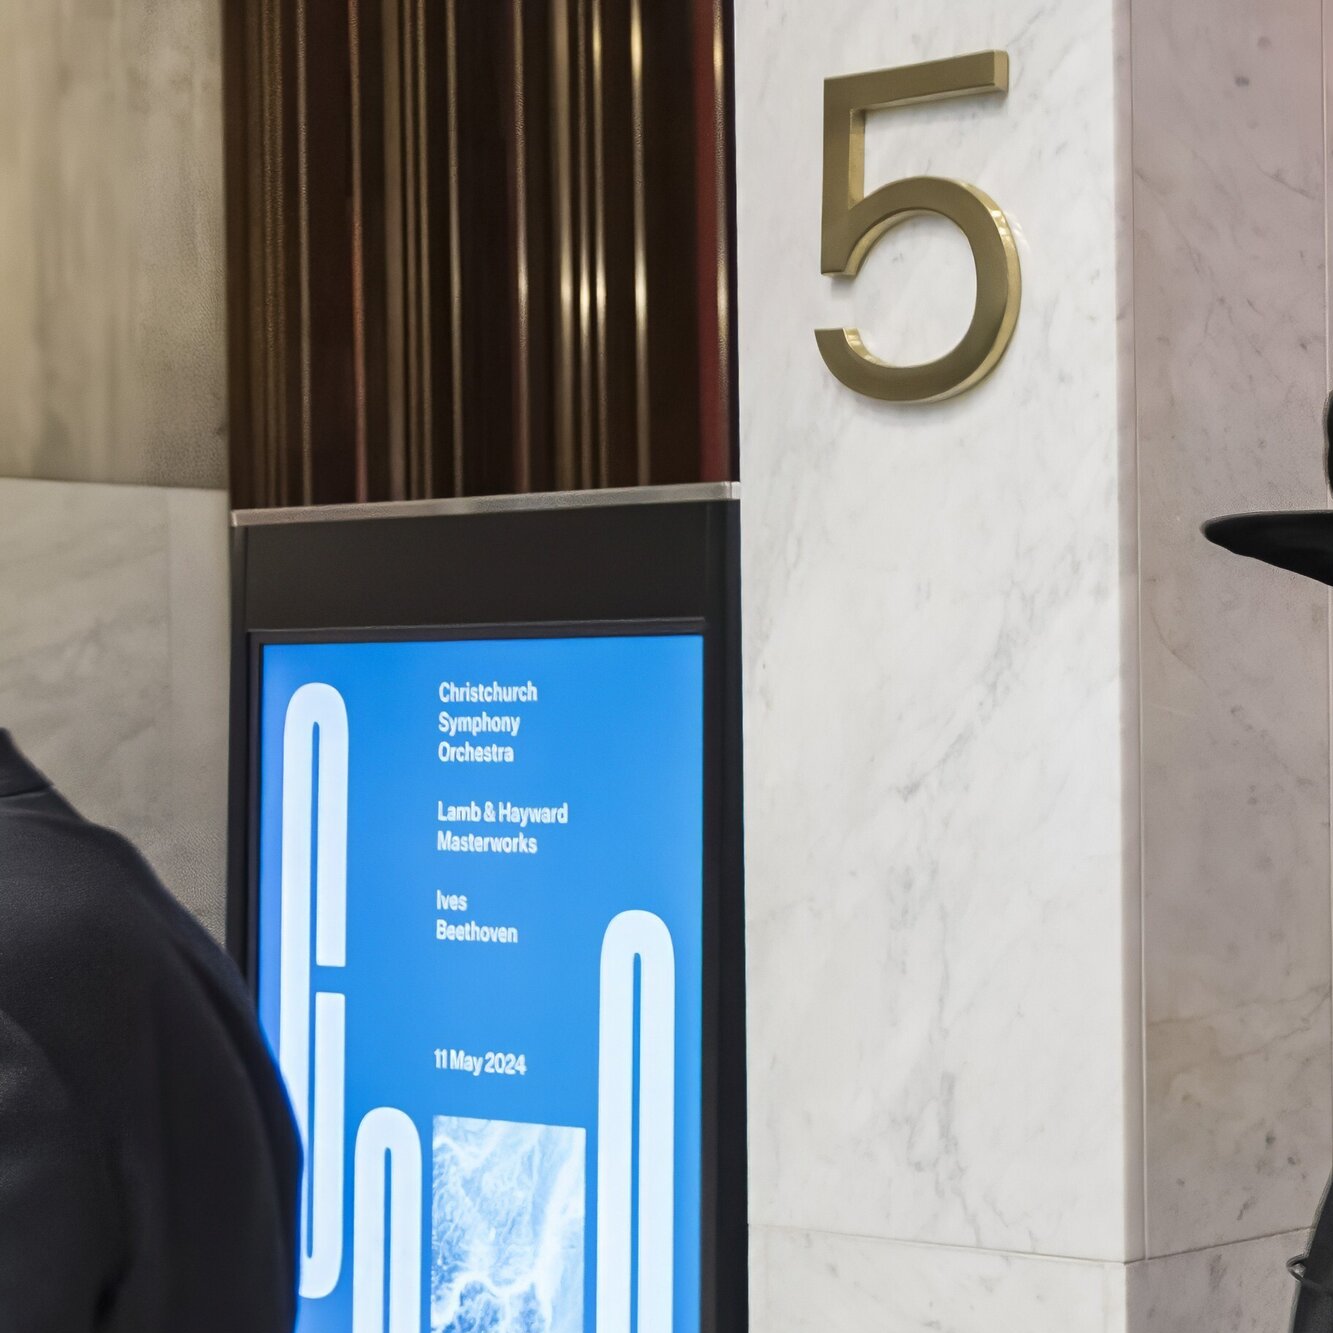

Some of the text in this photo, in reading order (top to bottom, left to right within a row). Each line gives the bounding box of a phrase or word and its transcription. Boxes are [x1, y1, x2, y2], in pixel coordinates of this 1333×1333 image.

[814, 49, 1022, 403] 5
[438, 681, 538, 703] Christchurch
[438, 711, 521, 737] Symphony
[438, 741, 514, 763] Orchestra
[437, 800, 568, 828] Lamb & Hayward
[437, 830, 538, 854] Masterworks
[436, 889, 468, 912] Ives
[436, 918, 518, 943] Beethoven
[434, 1048, 527, 1076] 11 May 2024
